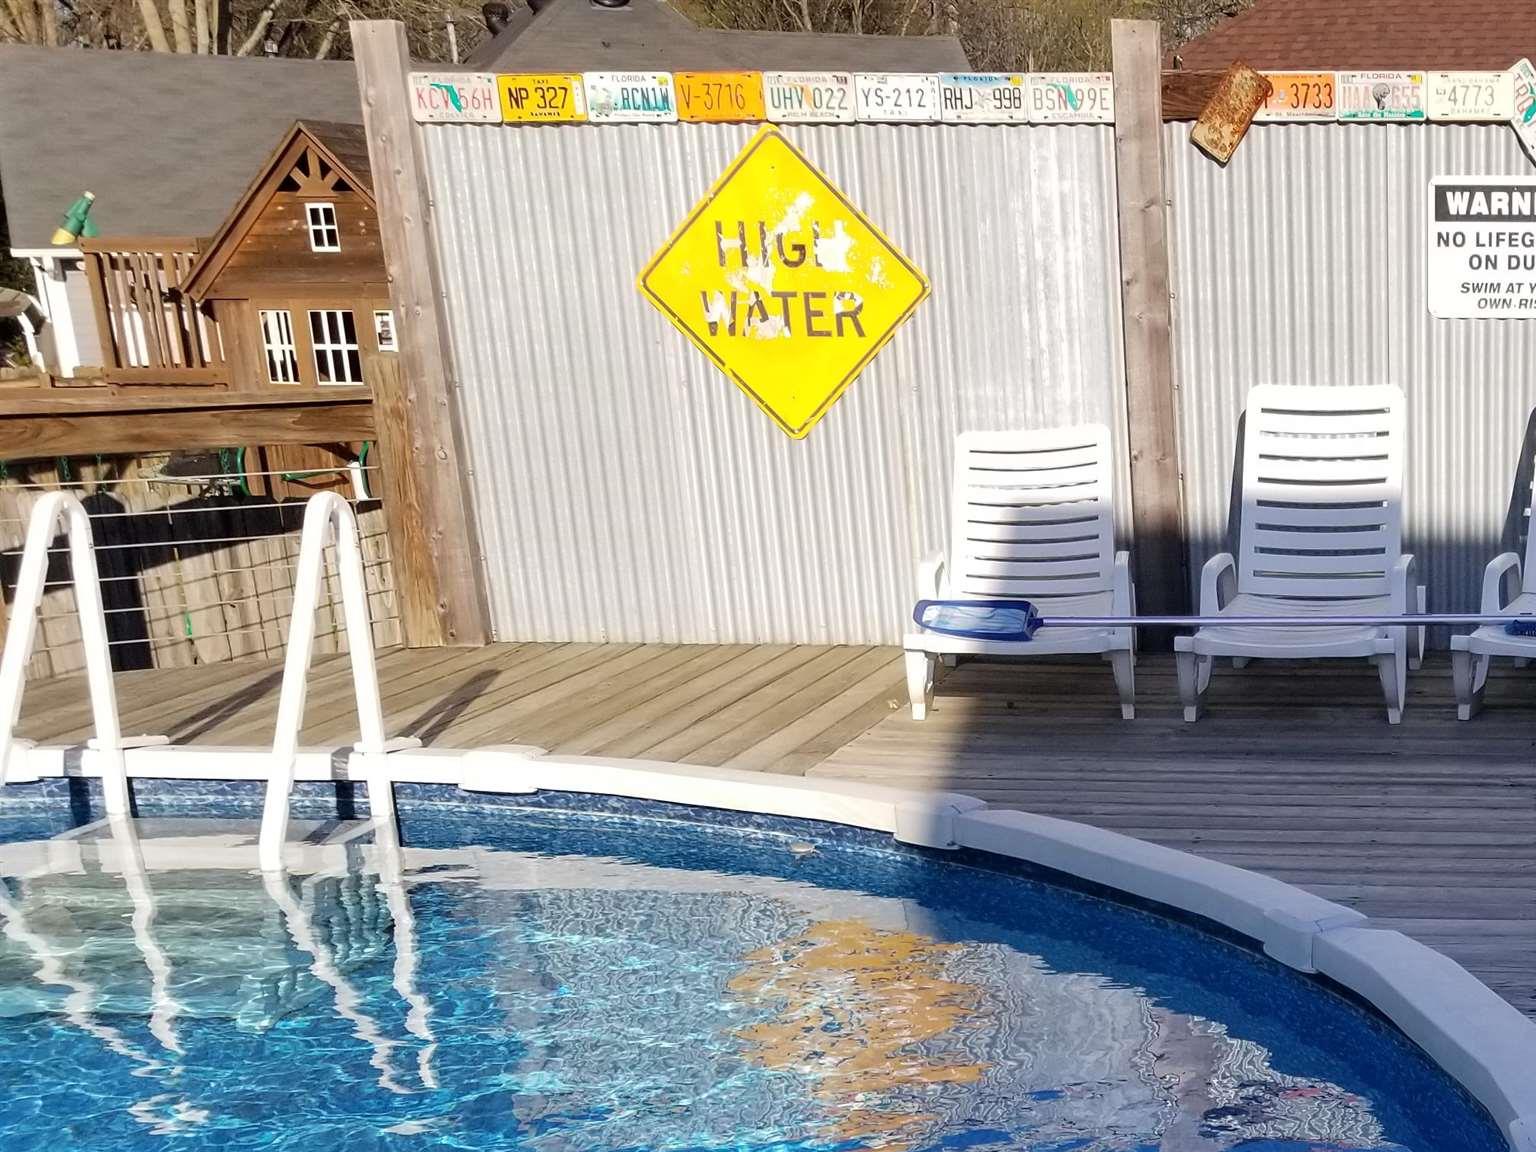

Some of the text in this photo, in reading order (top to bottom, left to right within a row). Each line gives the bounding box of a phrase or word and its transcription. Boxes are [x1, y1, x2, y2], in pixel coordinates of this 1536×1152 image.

[511, 87, 569, 110] NP 327
[770, 87, 849, 110] UHV 022
[861, 87, 926, 108] YS-212
[943, 87, 1022, 110] RHJ 998
[1290, 83, 1334, 109] 3733
[1446, 84, 1495, 106] 4773
[1437, 231, 1467, 248] NO
[1468, 254, 1498, 271] ON
[1460, 282, 1502, 295] SWIM
[1506, 282, 1525, 294] AT
[701, 290, 867, 338] WATER
[1477, 297, 1512, 310] OWN
